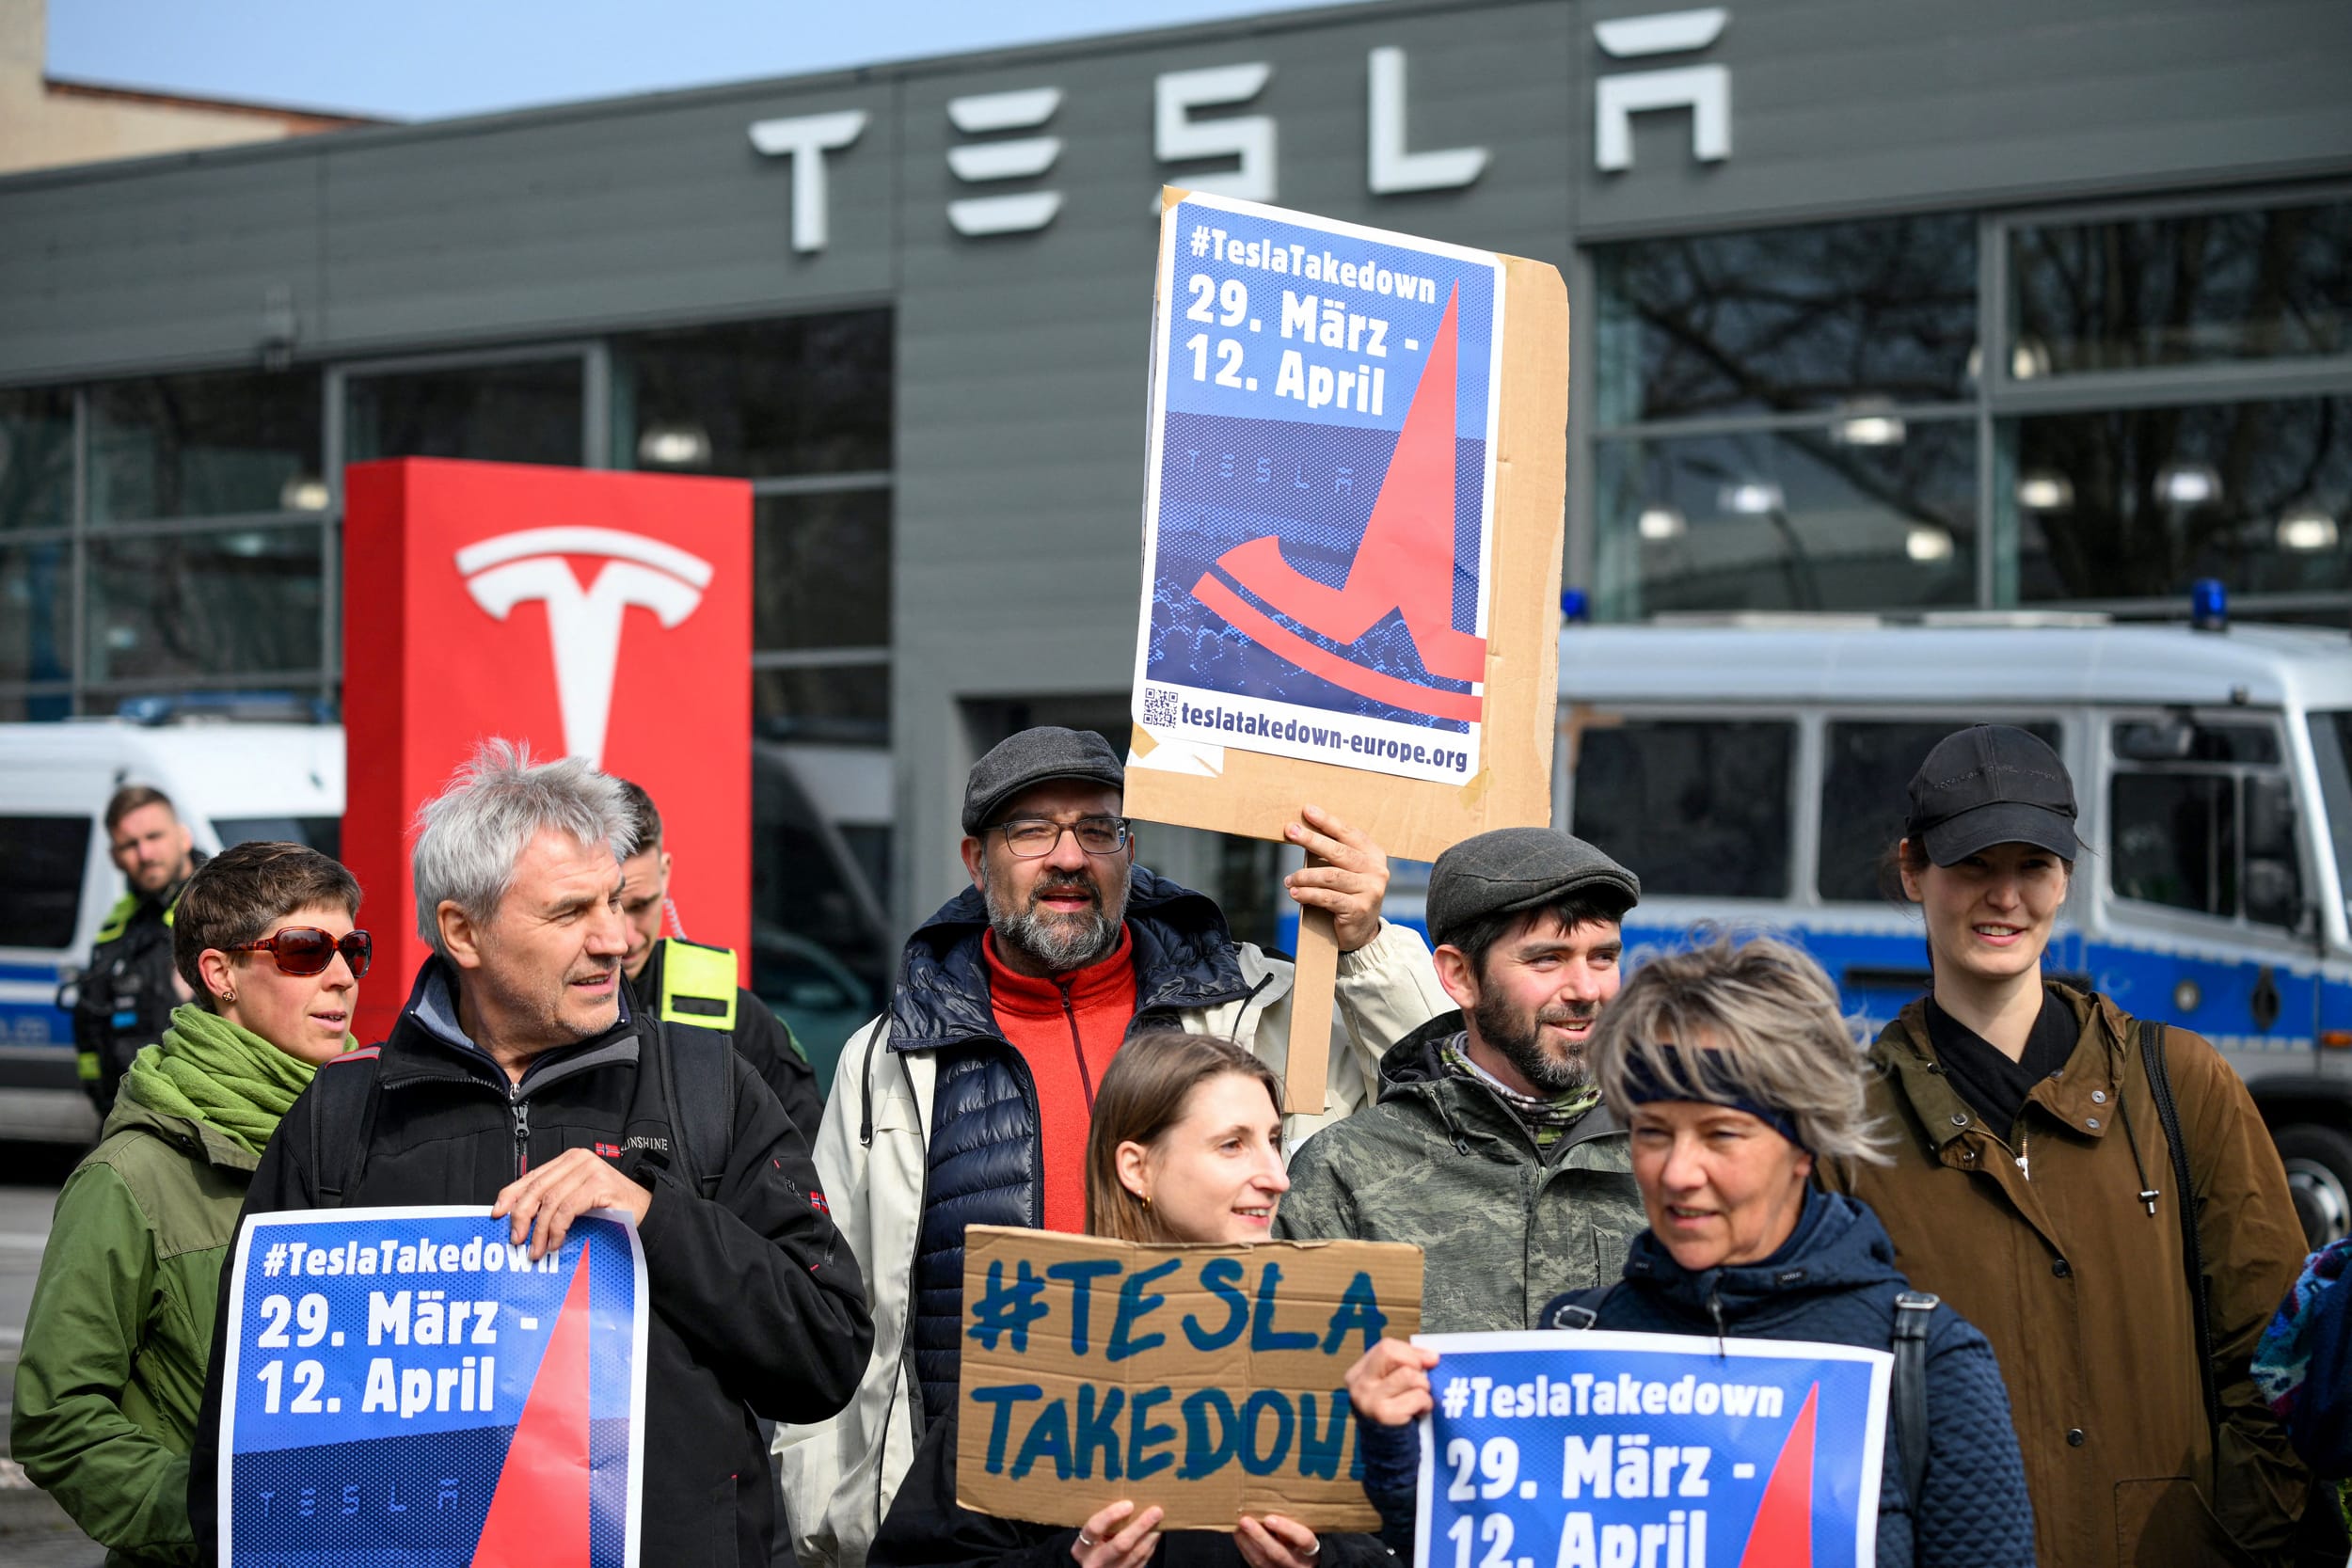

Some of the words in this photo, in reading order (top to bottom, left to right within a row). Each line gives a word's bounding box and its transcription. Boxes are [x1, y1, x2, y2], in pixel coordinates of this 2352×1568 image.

[748, 7, 1732, 253] TESLA
[1190, 224, 1436, 304] #TeslaTakedown
[1185, 274, 1262, 332] 29.
[1280, 290, 1389, 357] März
[1185, 333, 1258, 391] 12.
[1275, 349, 1386, 417] April
[1181, 702, 1468, 772] teslatakedown-europe.org
[263, 1236, 560, 1277] #TeslaTakedown
[257, 1293, 345, 1348] 29.
[367, 1290, 500, 1346] März
[966, 1258, 1389, 1362] #TESLA
[256, 1360, 342, 1414] 12.
[360, 1356, 496, 1418] April
[1442, 1373, 1784, 1419] #TeslaTakedown
[970, 1383, 1366, 1482] TAKEDOW
[1446, 1436, 1538, 1502] 29.
[1562, 1433, 1712, 1499] März
[1447, 1513, 1534, 1568] 12.
[1556, 1510, 1708, 1568] April
